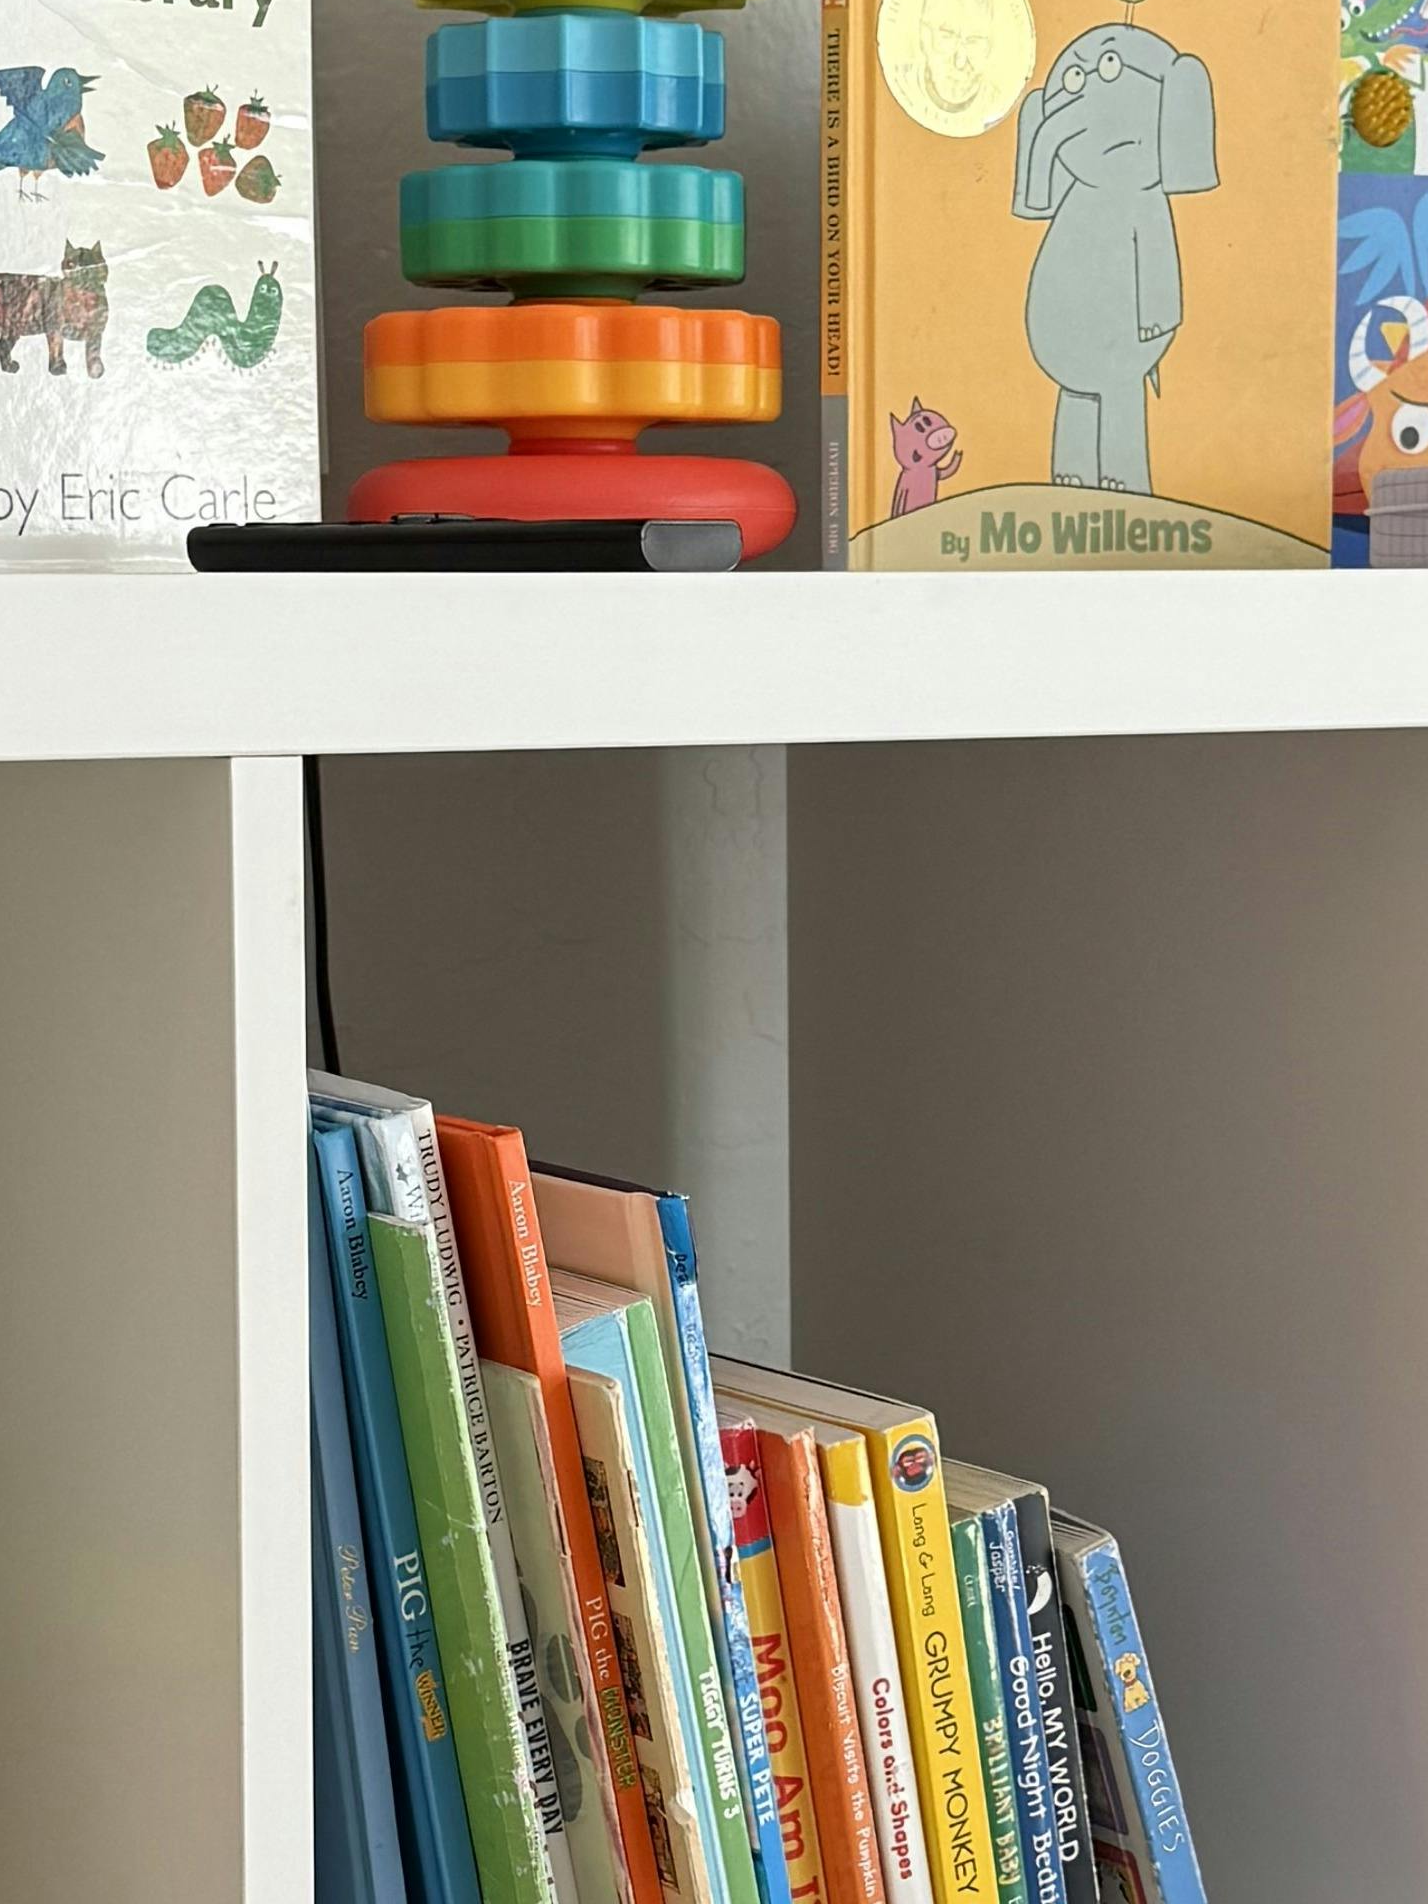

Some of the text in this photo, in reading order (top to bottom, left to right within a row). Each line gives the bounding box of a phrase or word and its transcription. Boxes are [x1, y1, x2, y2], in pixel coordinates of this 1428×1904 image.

[827, 28, 841, 377] THERE IS A BIRD ON YOUR HEAD!
[61, 472, 141, 520] Eric
[160, 474, 277, 521] Carle
[940, 509, 1213, 562] By Mo Willems
[338, 1168, 370, 1301] Aaron Blabey
[508, 1178, 544, 1309] Aaron Blabey
[418, 1128, 505, 1525] TRUDY LUDWIG PATRICE BARTON
[911, 1503, 928, 1549] Lang
[989, 1541, 1006, 1594] Jasper
[338, 1544, 369, 1653] Peter Pan
[921, 1573, 936, 1618] Lang
[1094, 1563, 1128, 1646] Boynton
[393, 1551, 448, 1738] PIG the WINNER
[509, 1638, 542, 1714] BRAVE
[585, 1596, 638, 1791] PIG the MONSTER
[831, 1660, 853, 1728] Biscuit
[924, 1630, 962, 1756] GRUMPY
[1009, 1654, 1037, 1731] Good
[525, 1718, 555, 1785] EVERY
[710, 1732, 737, 1801] TURNS
[739, 1691, 775, 1826] SUPER PETE
[750, 1632, 787, 1754] Moo
[772, 1774, 805, 1862] Am
[841, 1729, 861, 1786] Visits
[872, 1677, 894, 1751] Colors
[889, 1799, 913, 1881] Shapes
[983, 1713, 1016, 1825] BRILLIANT
[1018, 1734, 1047, 1820] Night
[1032, 1631, 1080, 1863] Hello, MY WORLD
[1128, 1718, 1185, 1853] DOGGIES
[536, 1792, 564, 1836] DAY
[723, 1803, 740, 1820] 3
[851, 1788, 865, 1822] the
[942, 1767, 981, 1894] MONKEY
[855, 1826, 877, 1898] Pumpkin
[995, 1829, 1022, 1886] BABY
